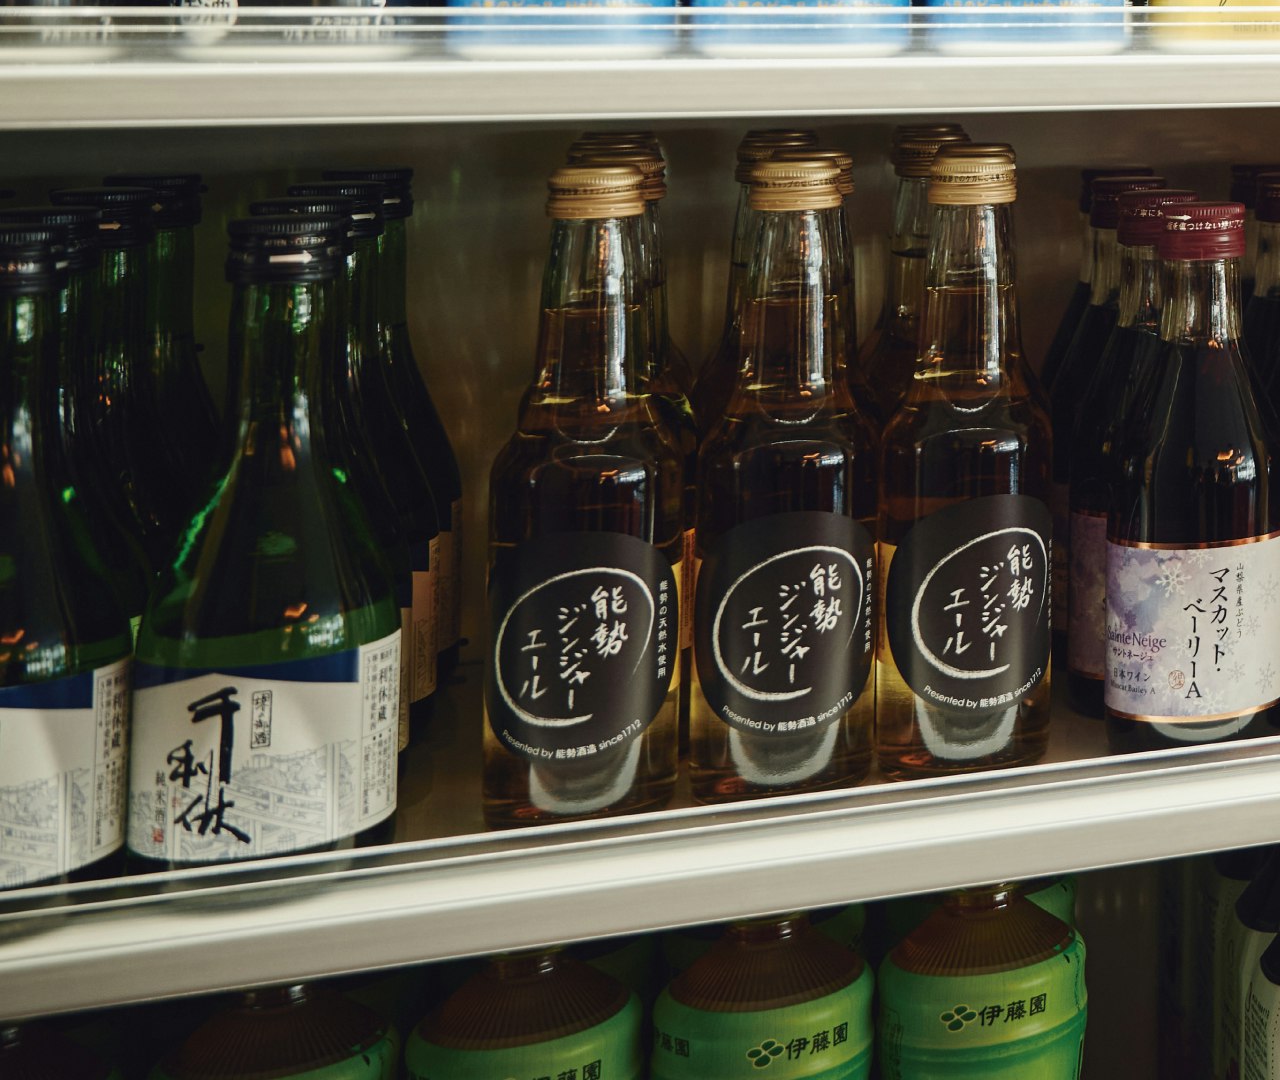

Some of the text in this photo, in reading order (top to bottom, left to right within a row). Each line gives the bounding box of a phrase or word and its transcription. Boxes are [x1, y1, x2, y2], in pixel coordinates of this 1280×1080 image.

[591, 585, 628, 659] 能勢
[943, 589, 972, 655] エール
[1236, 563, 1245, 639] 山梨県産ぶどう
[520, 629, 547, 699] エール
[558, 604, 591, 710] ジンジャー
[741, 607, 770, 675] エール
[1132, 636, 1167, 655] Neige
[1184, 598, 1206, 698] ベーリーA
[502, 730, 539, 756] Presented
[542, 749, 553, 759] by
[556, 744, 597, 759] 能勢酒造
[786, 1022, 849, 1060] 伊藤園
[978, 992, 1047, 1028] 伊藤園
